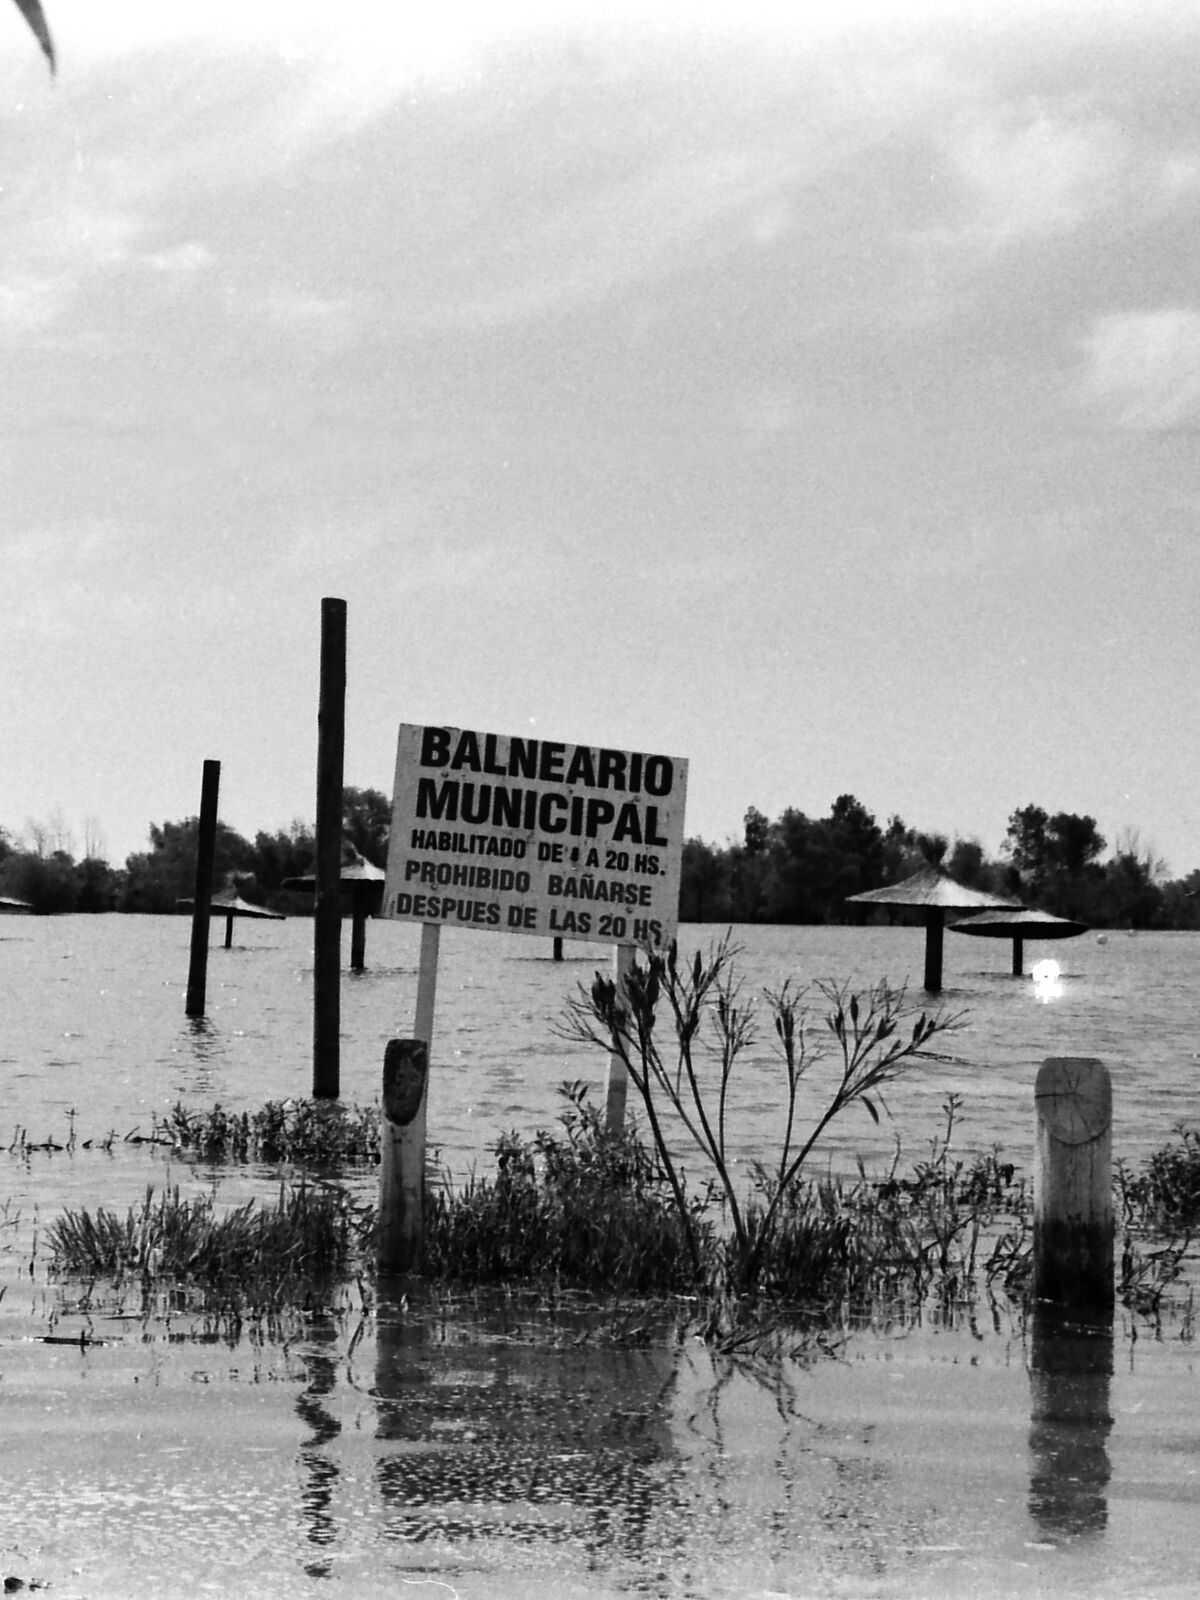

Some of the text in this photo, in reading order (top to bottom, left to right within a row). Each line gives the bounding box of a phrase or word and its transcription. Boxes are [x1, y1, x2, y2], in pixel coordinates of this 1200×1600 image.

[419, 726, 674, 797] BALNEARIO
[415, 777, 668, 847] MUNICIPAL
[411, 829, 526, 859] HABILITADO
[537, 842, 563, 863] DE
[585, 847, 599, 868] A
[605, 850, 629, 872] 20
[634, 853, 666, 876] HS.
[404, 860, 652, 907] PROHIBIDO BAÑARSE
[396, 893, 500, 925] DESPUES
[507, 905, 537, 929] DE
[549, 908, 592, 934] LAS
[598, 914, 627, 938] 20
